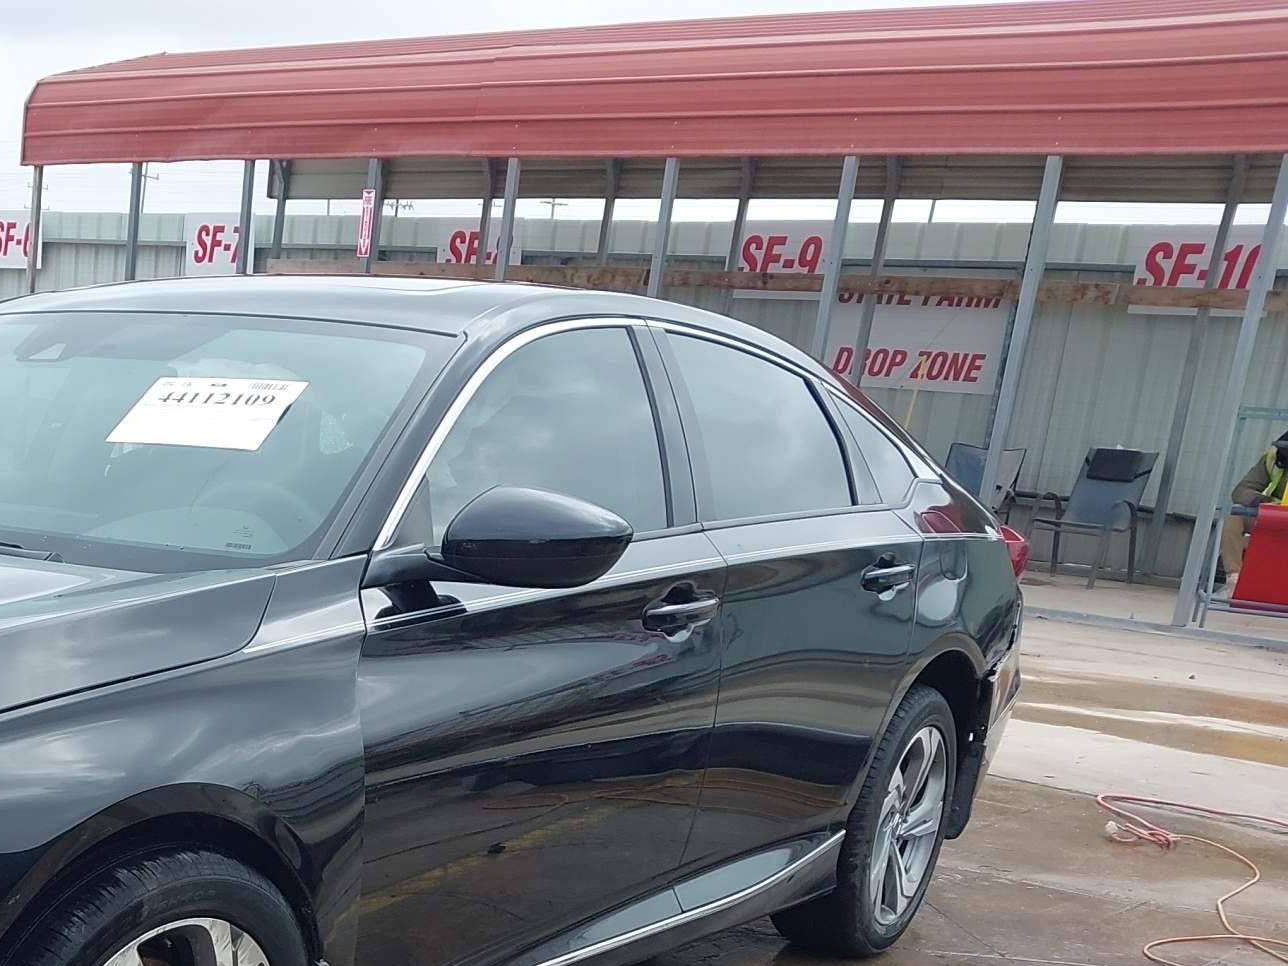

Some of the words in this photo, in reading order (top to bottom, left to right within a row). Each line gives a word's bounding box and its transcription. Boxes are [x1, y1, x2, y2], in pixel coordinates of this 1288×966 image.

[737, 234, 823, 274] SF-9
[909, 350, 987, 383] ZONE
[158, 391, 276, 406] 44112109
